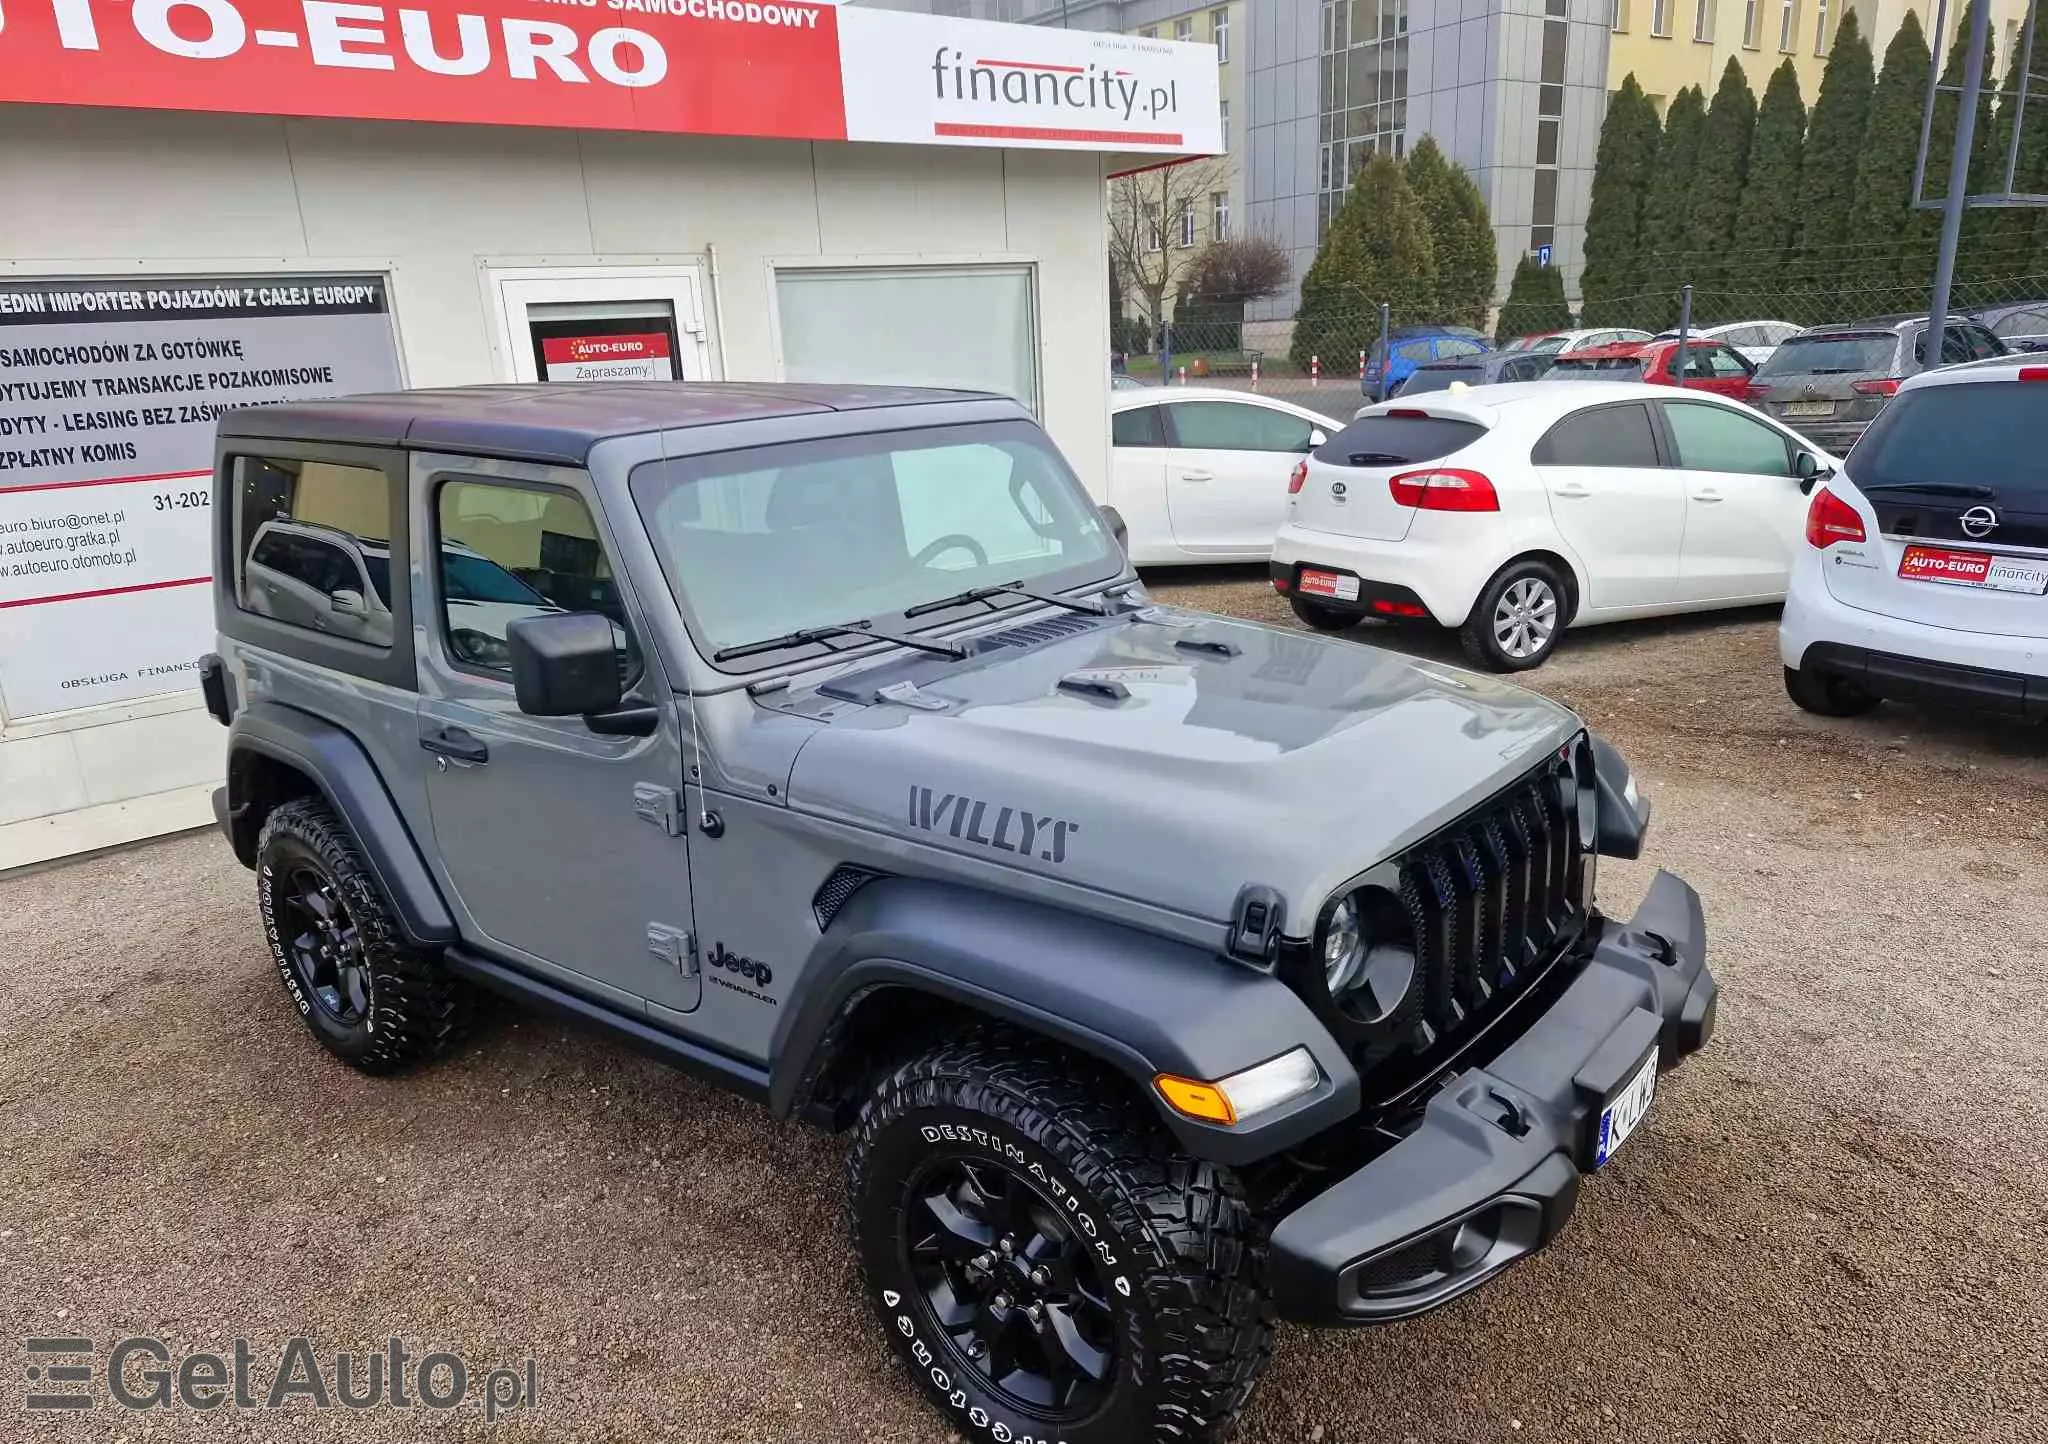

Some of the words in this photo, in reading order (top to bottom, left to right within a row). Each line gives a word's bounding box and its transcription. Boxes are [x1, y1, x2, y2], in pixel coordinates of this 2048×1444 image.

[0, 0, 667, 88] TO-EURO
[931, 47, 1177, 121] financity.pl
[0, 293, 46, 313] EDNI
[49, 291, 145, 312] IMPORTER
[147, 285, 240, 309] POJAZDÓW
[244, 288, 257, 307] Z
[259, 286, 310, 306] CAŁEJ
[313, 285, 374, 304] EUROPY
[0, 340, 129, 367] SAMOCHODÓW
[133, 343, 157, 361] ZA
[161, 338, 244, 361] GOTÓWKĘ
[578, 341, 644, 354] AUTO-EURO
[92, 373, 204, 396] TRANSAKCJE
[208, 366, 333, 390] POZAKOMISOWE
[0, 415, 46, 436] DYTY
[62, 409, 139, 432] LEASING
[142, 407, 175, 426] BEZ
[80, 441, 137, 463] KOMIS
[153, 490, 210, 511] 31-202
[1910, 557, 1985, 574] AUTO-EURO
[61, 671, 128, 689] OBSŁUGA
[909, 785, 1080, 863] WILLYS
[707, 942, 772, 987] Jeep
[920, 1124, 1118, 1266] DESTINATION
